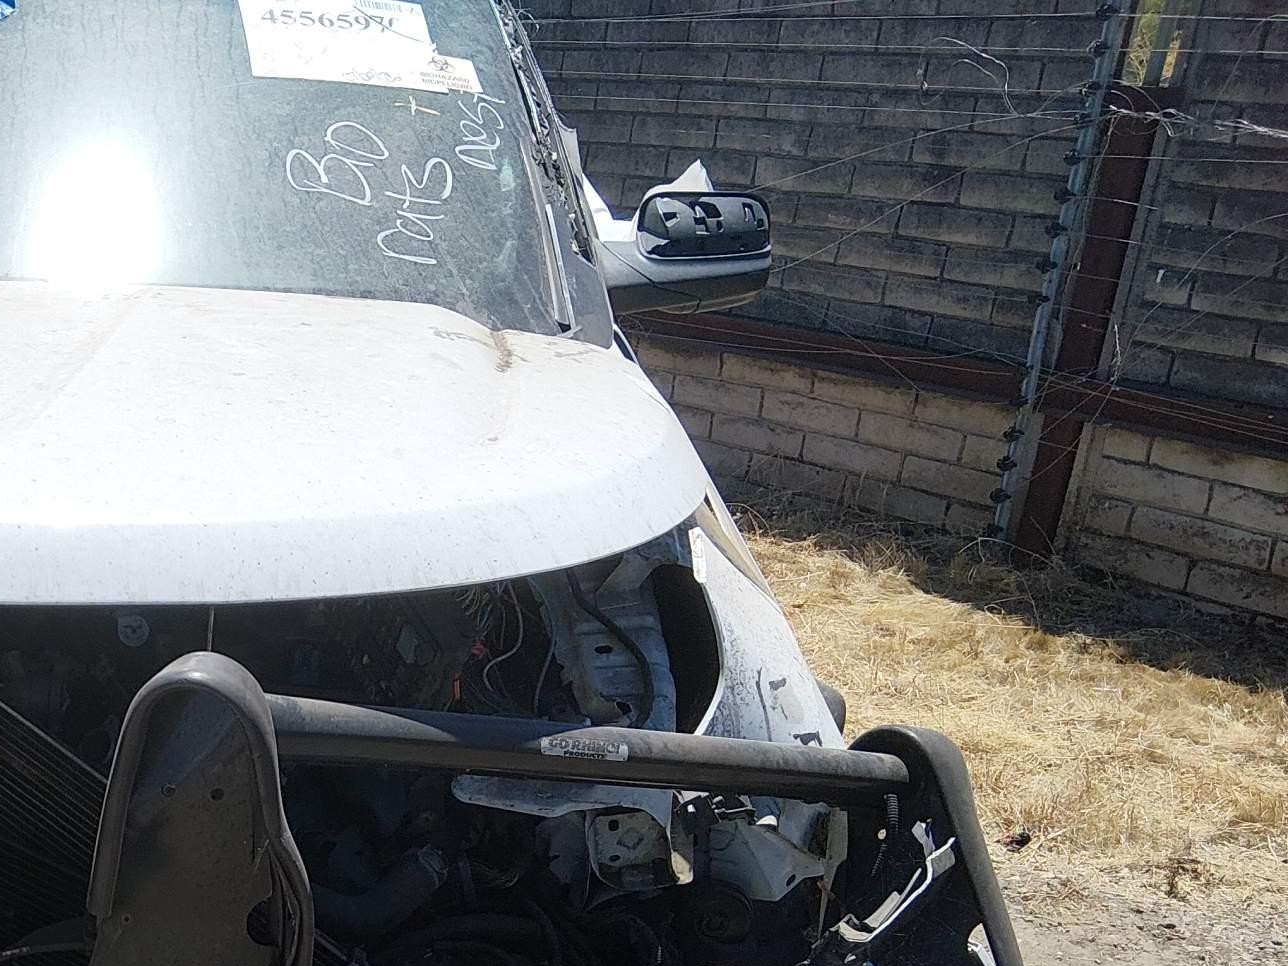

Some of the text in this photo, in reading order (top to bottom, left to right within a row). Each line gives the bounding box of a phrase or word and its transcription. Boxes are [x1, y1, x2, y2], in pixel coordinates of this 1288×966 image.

[420, 71, 471, 84] BIOHAZARD
[548, 737, 569, 749] GO
[563, 749, 606, 759] PRODUCTS
